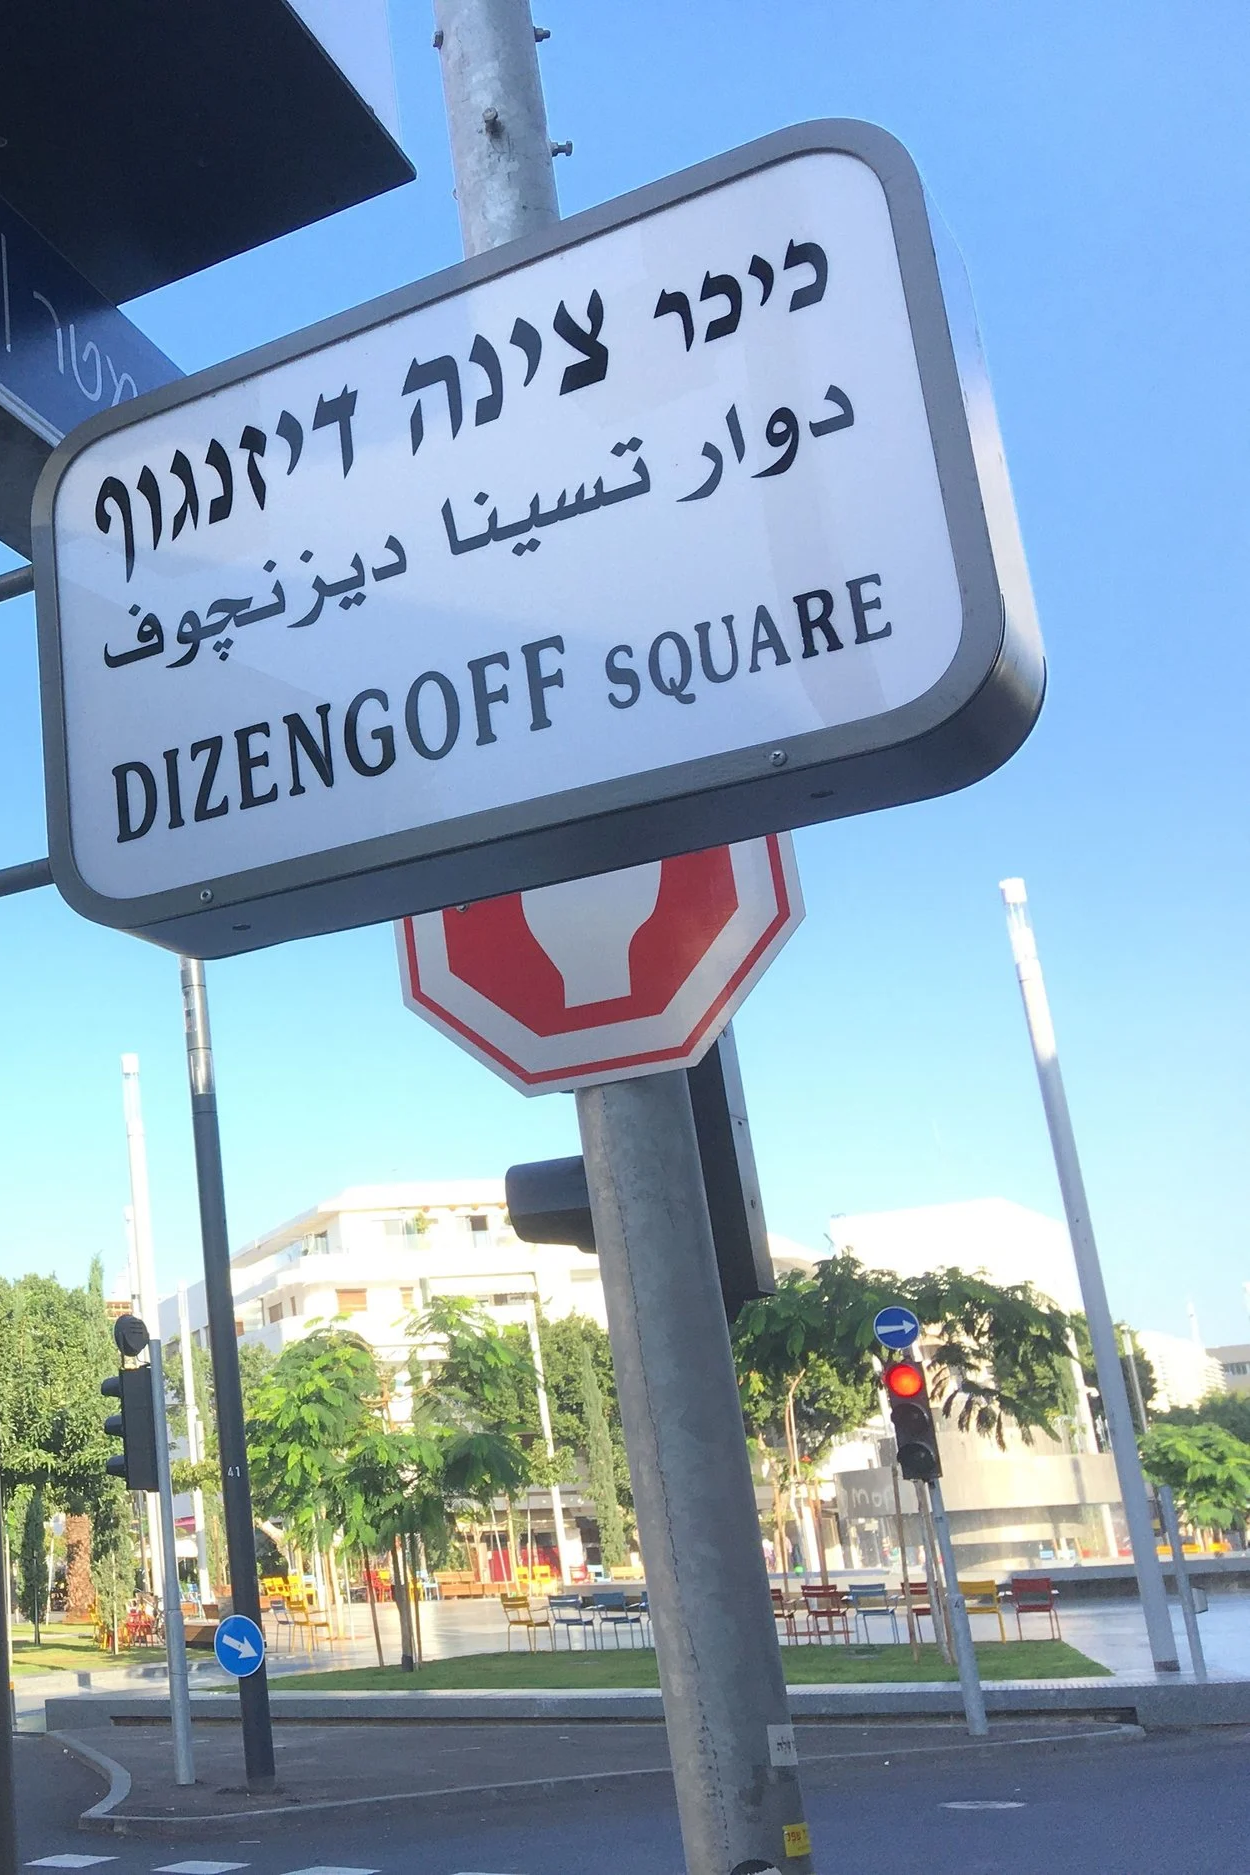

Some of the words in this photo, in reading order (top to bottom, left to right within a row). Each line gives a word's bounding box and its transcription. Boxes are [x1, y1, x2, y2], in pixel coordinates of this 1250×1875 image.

[654, 238, 828, 352] כיכר
[401, 288, 609, 456] צינה
[95, 384, 358, 583] דיזנגוף
[441, 436, 650, 556] تسينا
[676, 384, 854, 502] دوار
[111, 634, 565, 844] DIZENGOFF
[604, 572, 893, 709] SQUARE
[227, 1466, 240, 1478] 41
